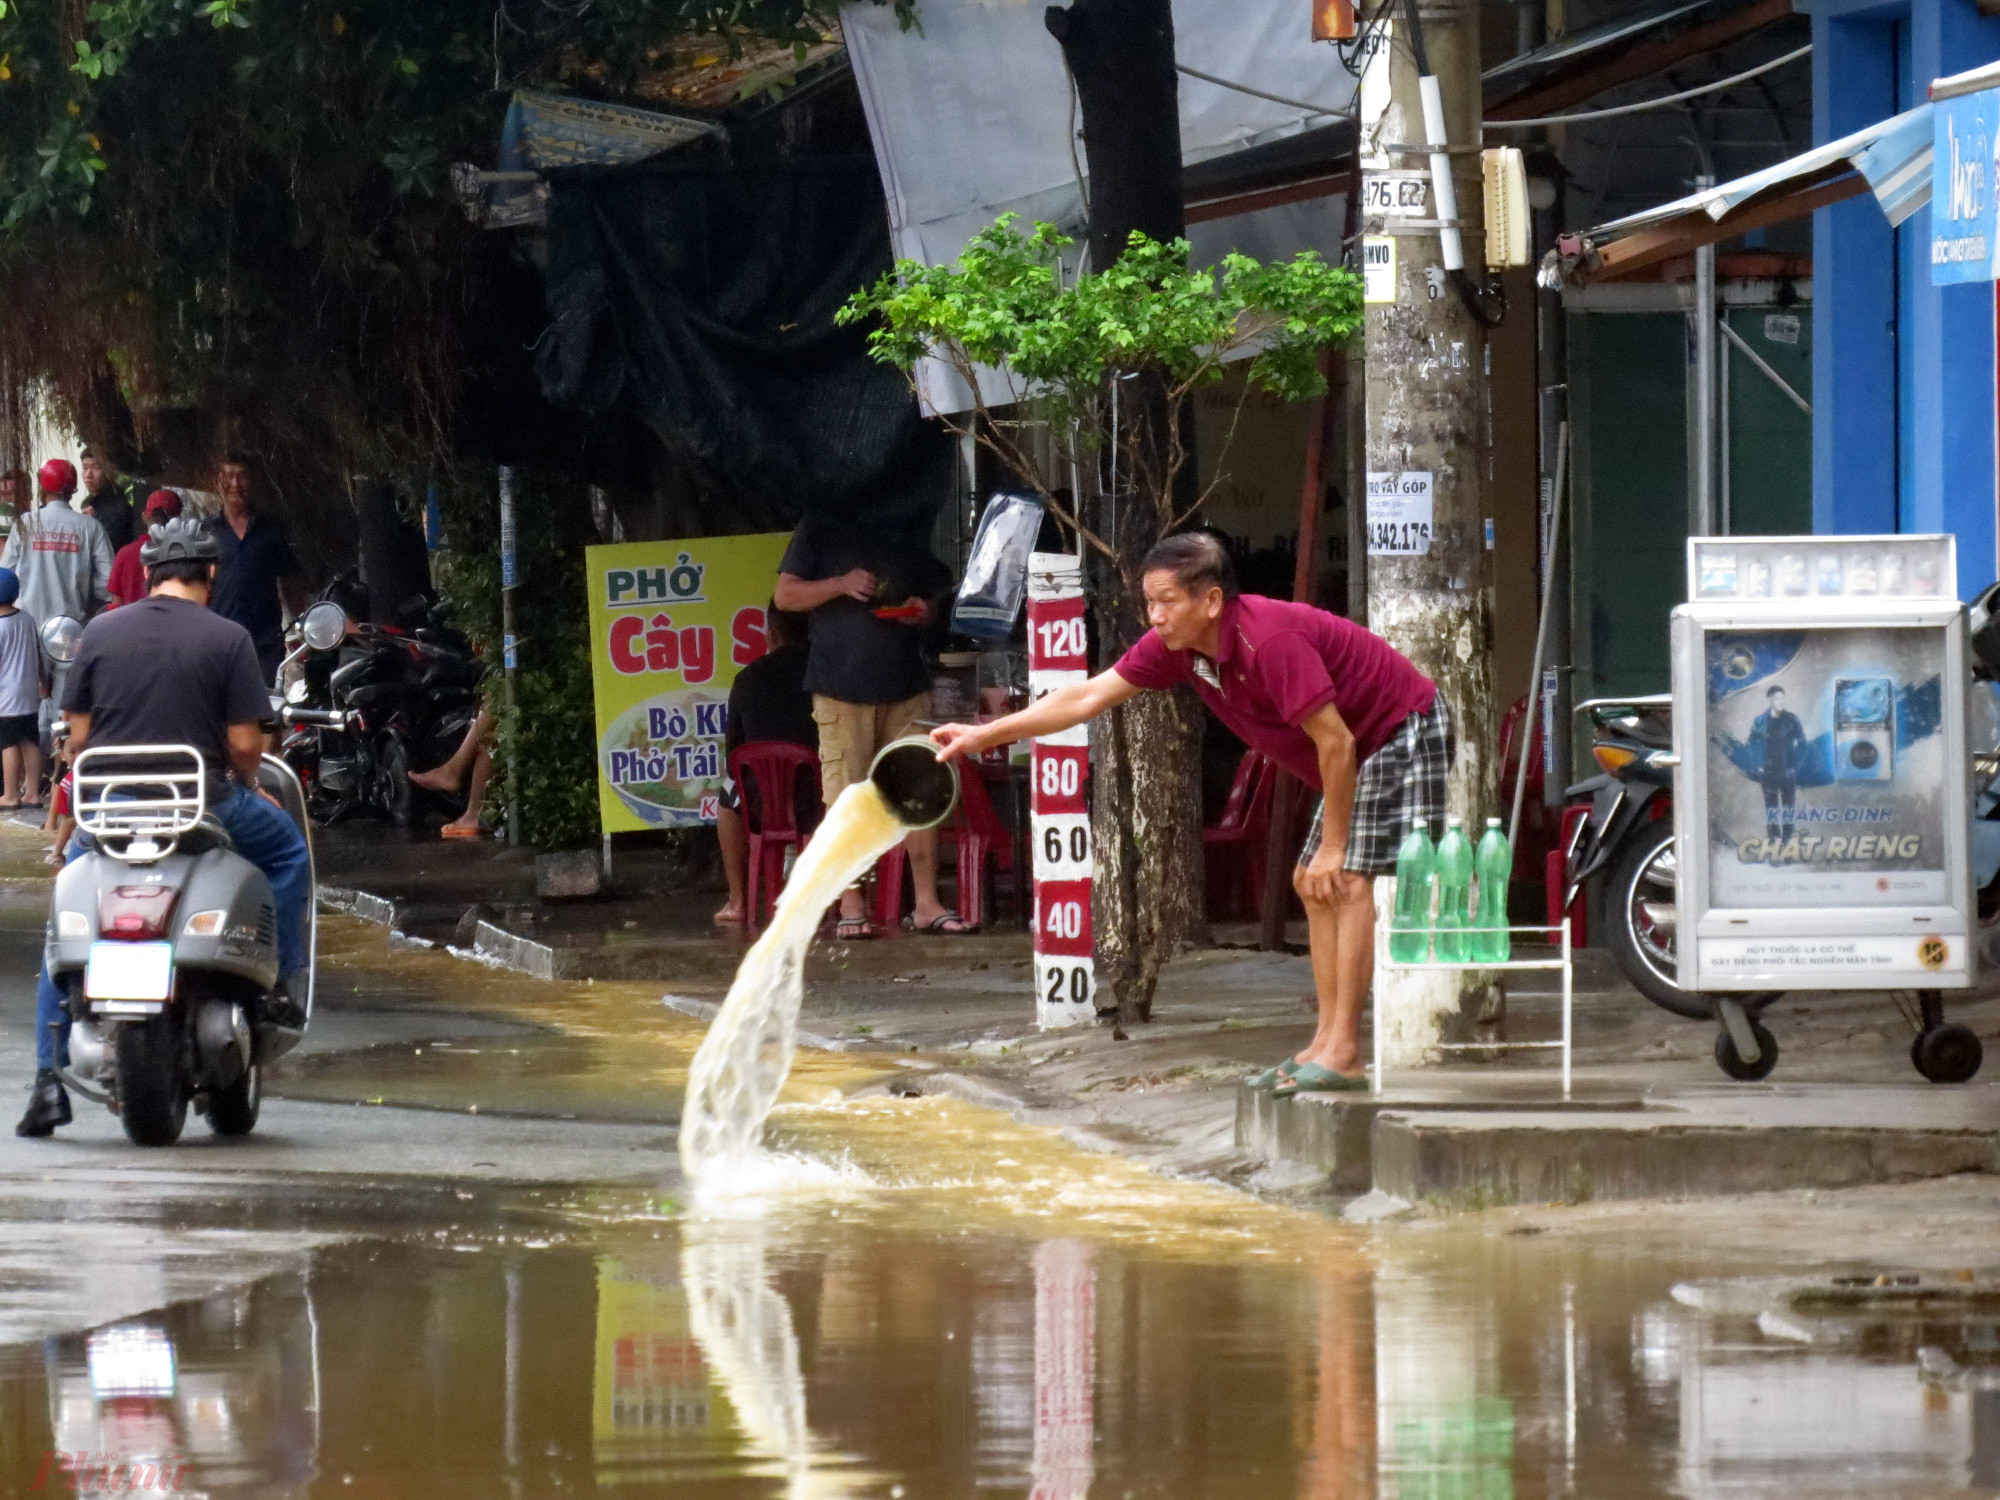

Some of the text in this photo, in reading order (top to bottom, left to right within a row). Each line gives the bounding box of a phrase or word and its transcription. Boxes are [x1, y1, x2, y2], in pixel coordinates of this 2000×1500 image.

[1402, 478, 1427, 494] GÓP
[607, 553, 704, 601] PHỞ
[610, 613, 714, 684] Cây
[1037, 616, 1087, 658] 120
[648, 707, 687, 740] Bò
[611, 744, 719, 783] Phở Tái
[1041, 757, 1079, 796] 80
[1044, 826, 1088, 863] 60
[1046, 901, 1081, 939] 40
[1046, 966, 1089, 1004] 20
